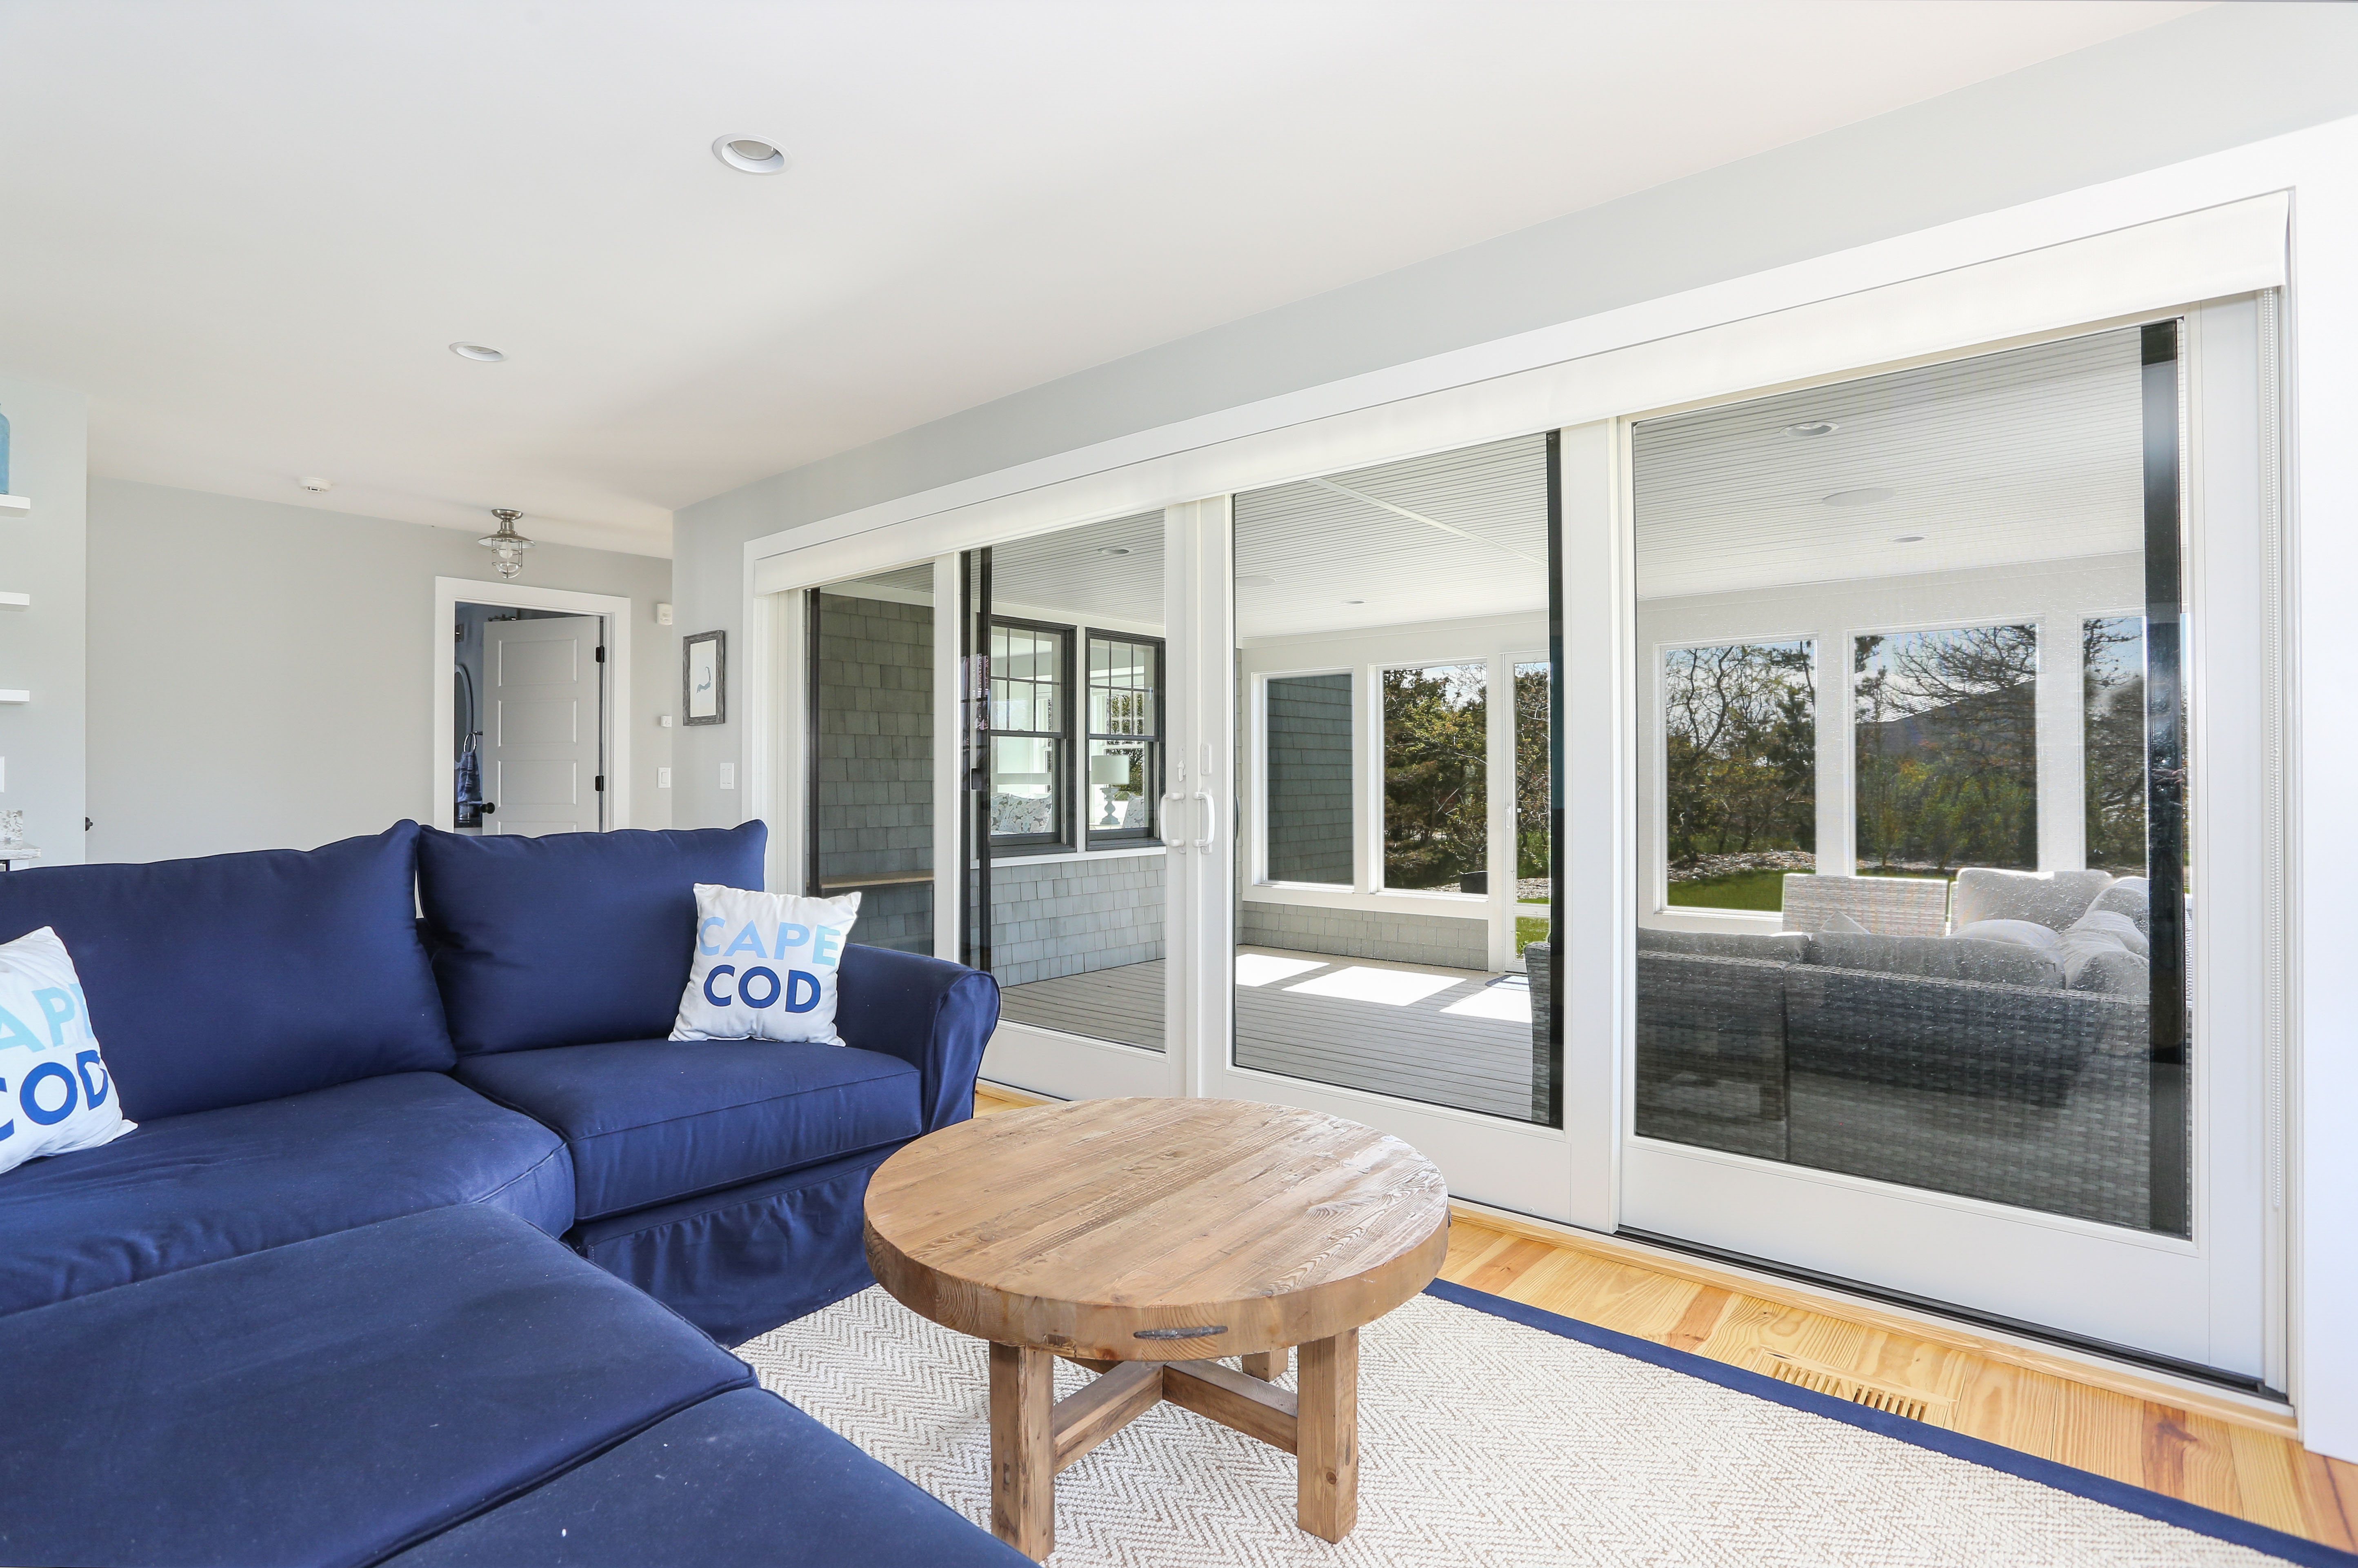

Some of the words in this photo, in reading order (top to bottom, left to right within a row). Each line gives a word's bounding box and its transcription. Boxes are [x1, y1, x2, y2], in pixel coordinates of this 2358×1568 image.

[699, 917, 841, 966] CAPE
[703, 964, 821, 1013] COD
[0, 982, 94, 1053] AP
